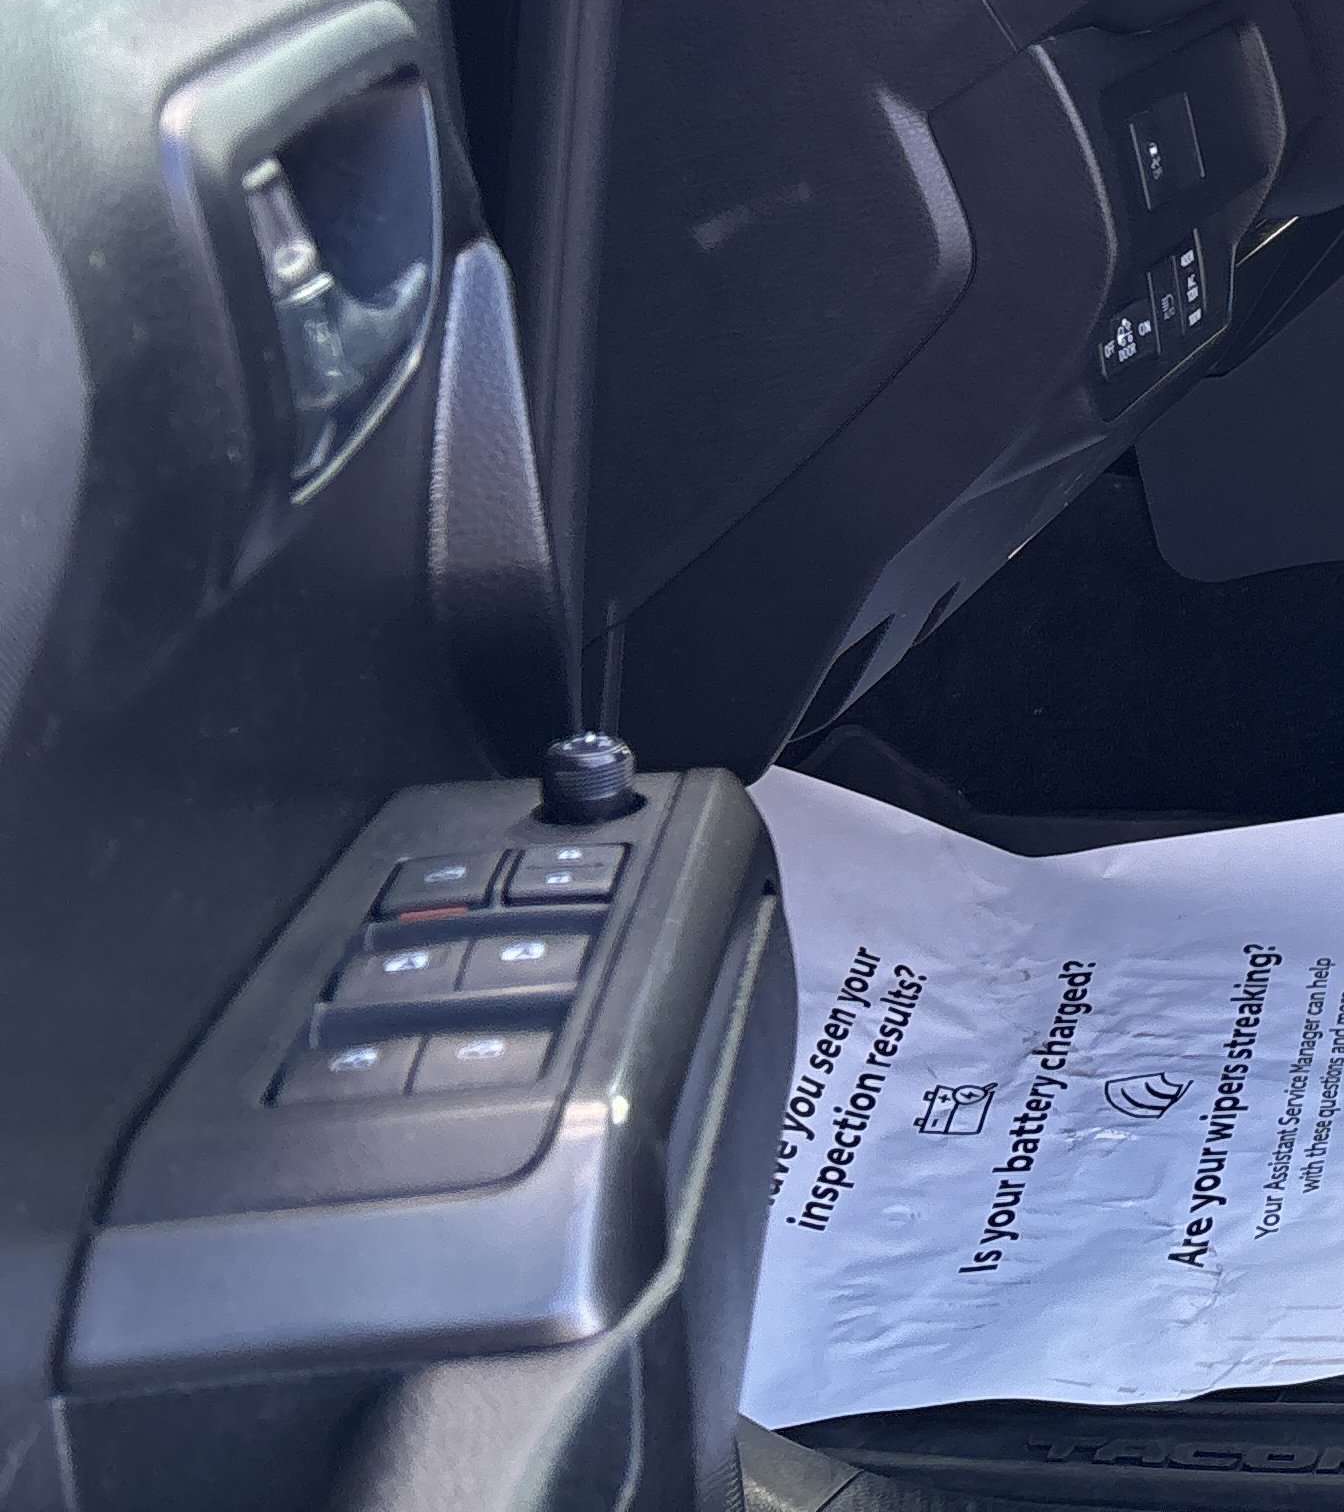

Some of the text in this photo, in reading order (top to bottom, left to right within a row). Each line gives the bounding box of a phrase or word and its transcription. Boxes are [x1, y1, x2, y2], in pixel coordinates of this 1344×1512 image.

[770, 946, 880, 1205] ave you seen your
[786, 964, 927, 1231] inspection results?
[959, 960, 1096, 1273] Is your battery charged?
[1168, 944, 1282, 1268] Are your wipers streaking?
[1254, 957, 1336, 1239] Your Assistant Service Manager can help
[1299, 1160, 1322, 1193] with
[1304, 1120, 1332, 1157] these
[1320, 1057, 1344, 1117] questions
